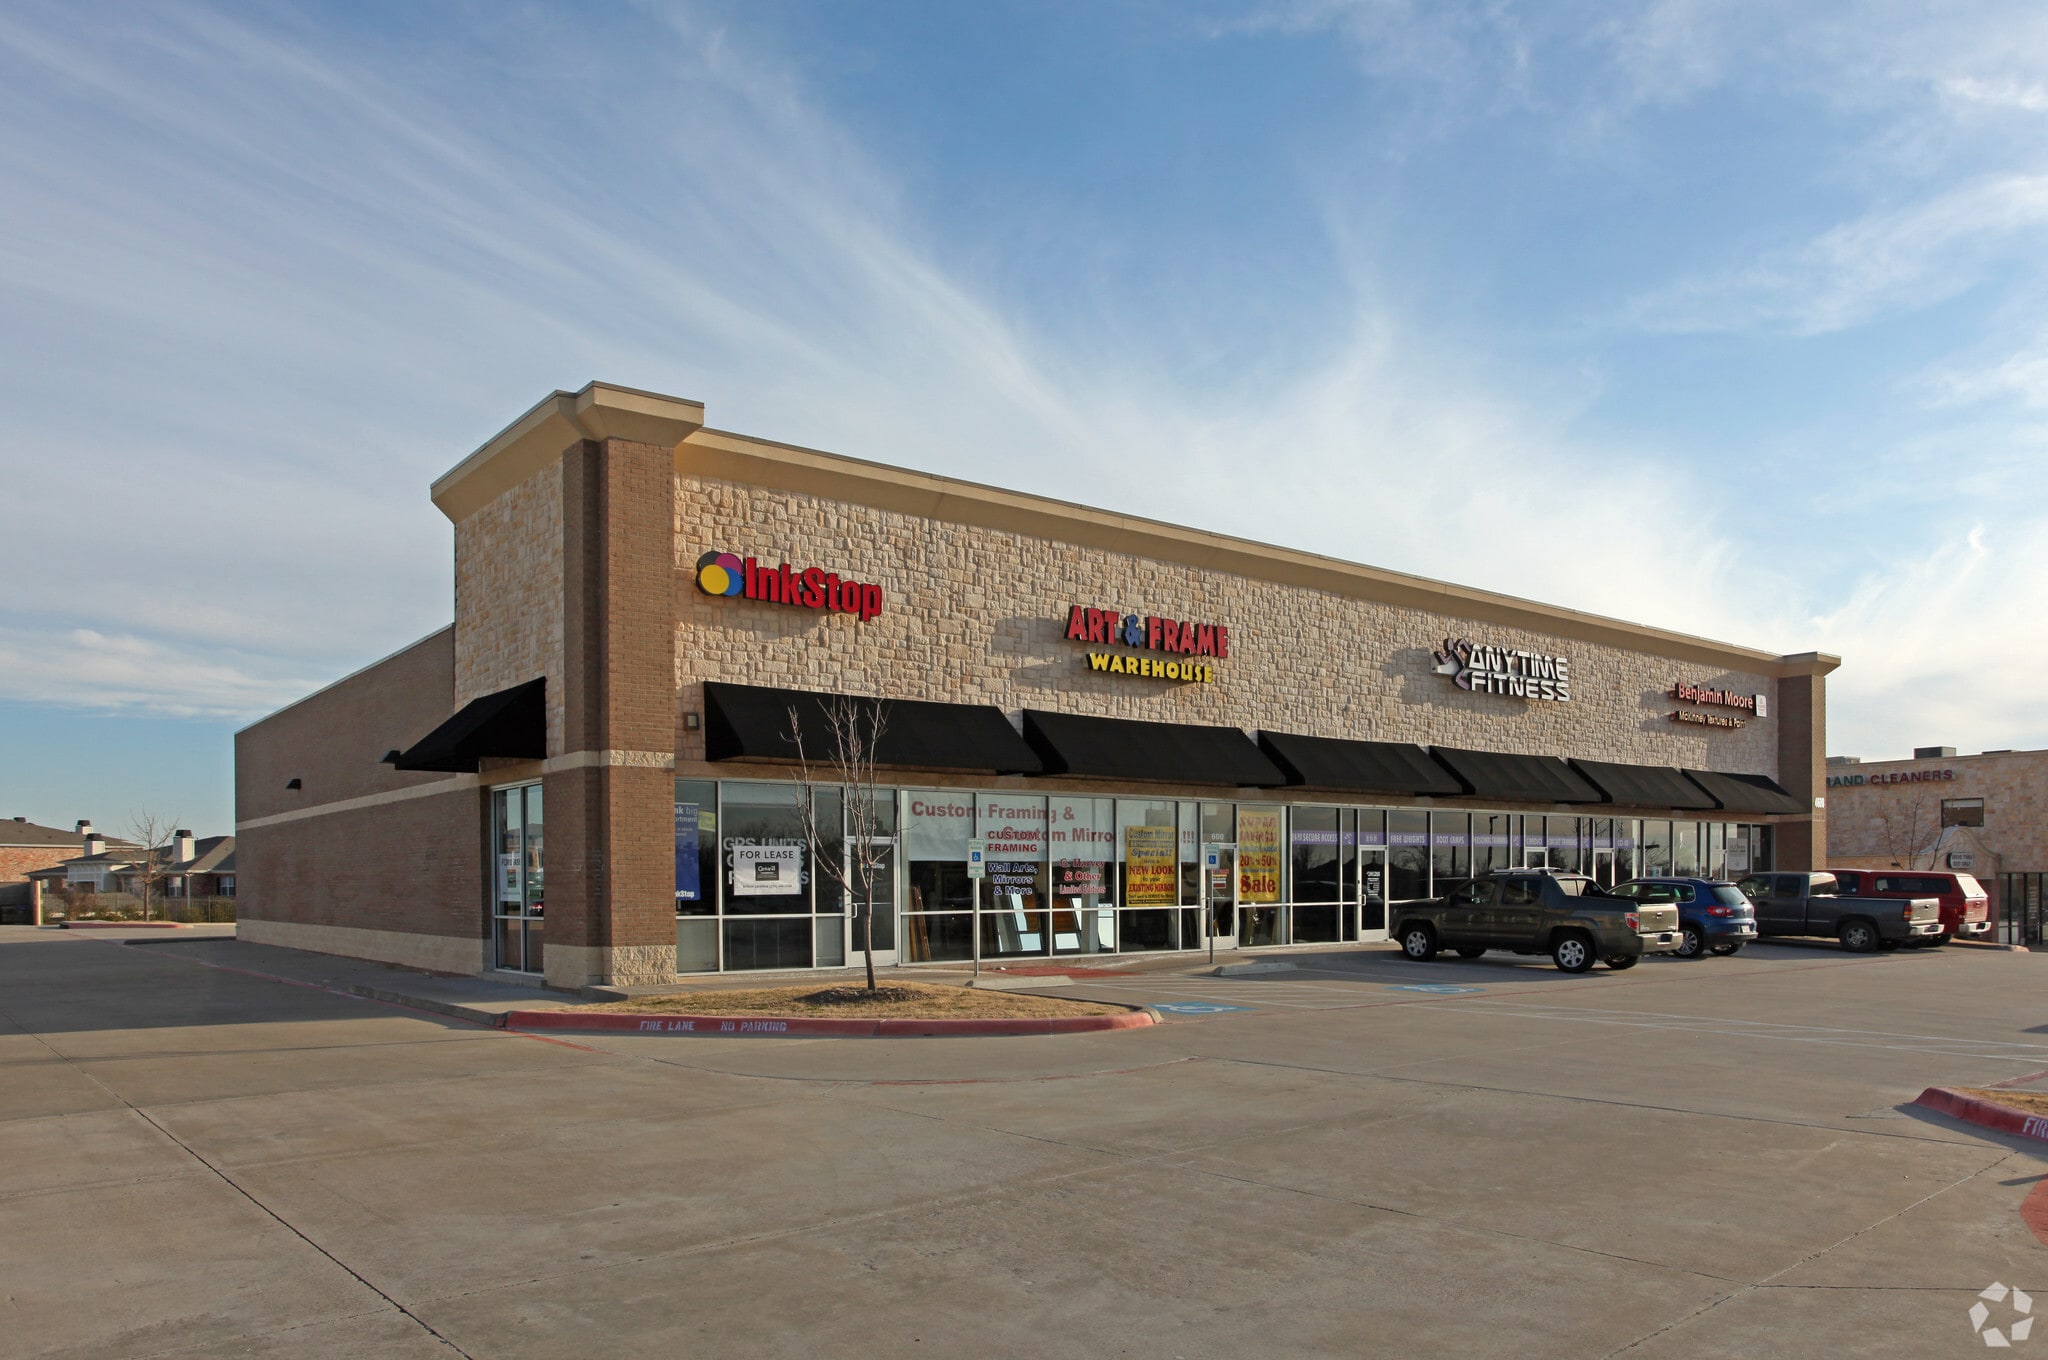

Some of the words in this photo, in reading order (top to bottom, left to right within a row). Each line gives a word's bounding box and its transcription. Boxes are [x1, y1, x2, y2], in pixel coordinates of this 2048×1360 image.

[744, 557, 882, 622] InkStop
[1066, 605, 1119, 645] ART
[1123, 614, 1142, 648] &
[1146, 616, 1228, 658] FRAME
[1088, 652, 1213, 684] WAREHOUSE
[1469, 644, 1569, 681] ANYTIME
[1471, 671, 1571, 702] FITNESS
[1679, 683, 1722, 705] Benjamin
[1725, 690, 1753, 709] Moore
[1870, 770, 1953, 786] CLEANERS
[911, 801, 981, 818] Custom
[988, 804, 1057, 823] Framing
[1063, 807, 1075, 821] &
[988, 831, 1038, 840] CUSTOM
[1391, 835, 1402, 844] FREE
[1403, 835, 1425, 844] WEIGHTS
[988, 844, 1038, 853] FRAMING
[740, 851, 760, 859] FOR
[765, 851, 793, 859] LEASE
[988, 863, 1010, 873] Wall
[1013, 863, 1038, 874] Arts,
[1129, 866, 1149, 875] NEW
[1152, 866, 1174, 875] LOOK
[993, 874, 1033, 884] Mirrors
[1064, 871, 1073, 881] &
[1075, 871, 1102, 881] Other
[1129, 884, 1153, 892] EXISTING
[1155, 884, 1174, 892] MIRROR
[1241, 875, 1276, 893] Sale
[994, 886, 1002, 895] &
[1005, 886, 1032, 895] More
[640, 1020, 661, 1031] FIRE
[668, 1021, 695, 1031] LANE
[721, 1021, 735, 1032] NO
[740, 1021, 786, 1032] PARKING
